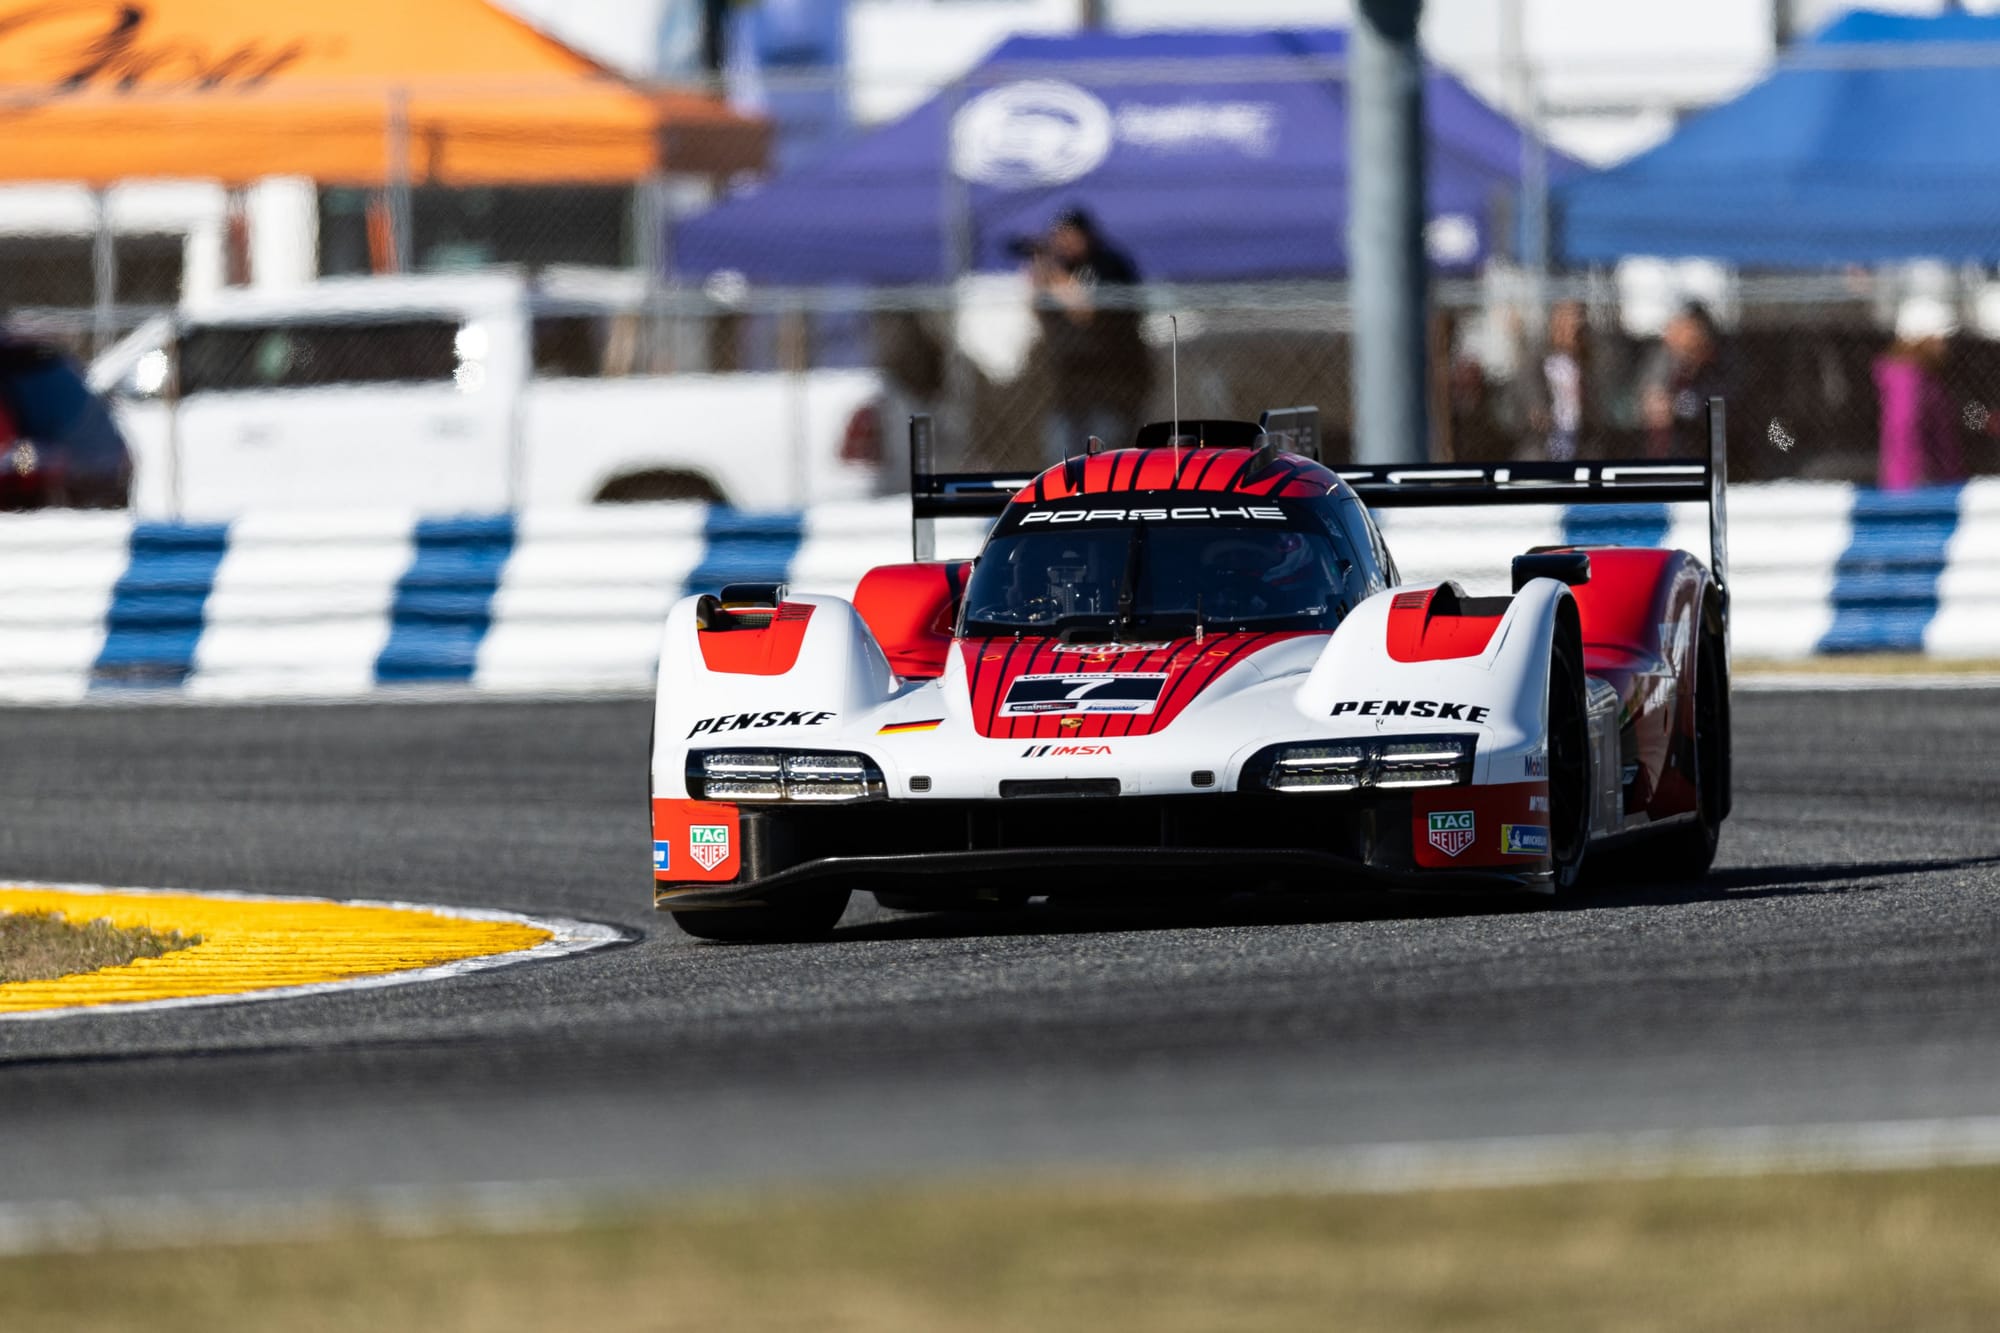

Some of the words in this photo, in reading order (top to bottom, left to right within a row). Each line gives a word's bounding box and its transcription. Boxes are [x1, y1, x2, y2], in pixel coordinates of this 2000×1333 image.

[1019, 506, 1287, 526] PORSCHE
[1062, 678, 1114, 699] 7
[1330, 700, 1490, 724] PENSKE
[686, 711, 837, 740] PENSKE
[1050, 745, 1112, 756] IMSA
[1432, 814, 1470, 829] TAG
[693, 828, 726, 843] TAG
[1432, 831, 1473, 853] HEUER
[691, 844, 726, 866] HEUER
